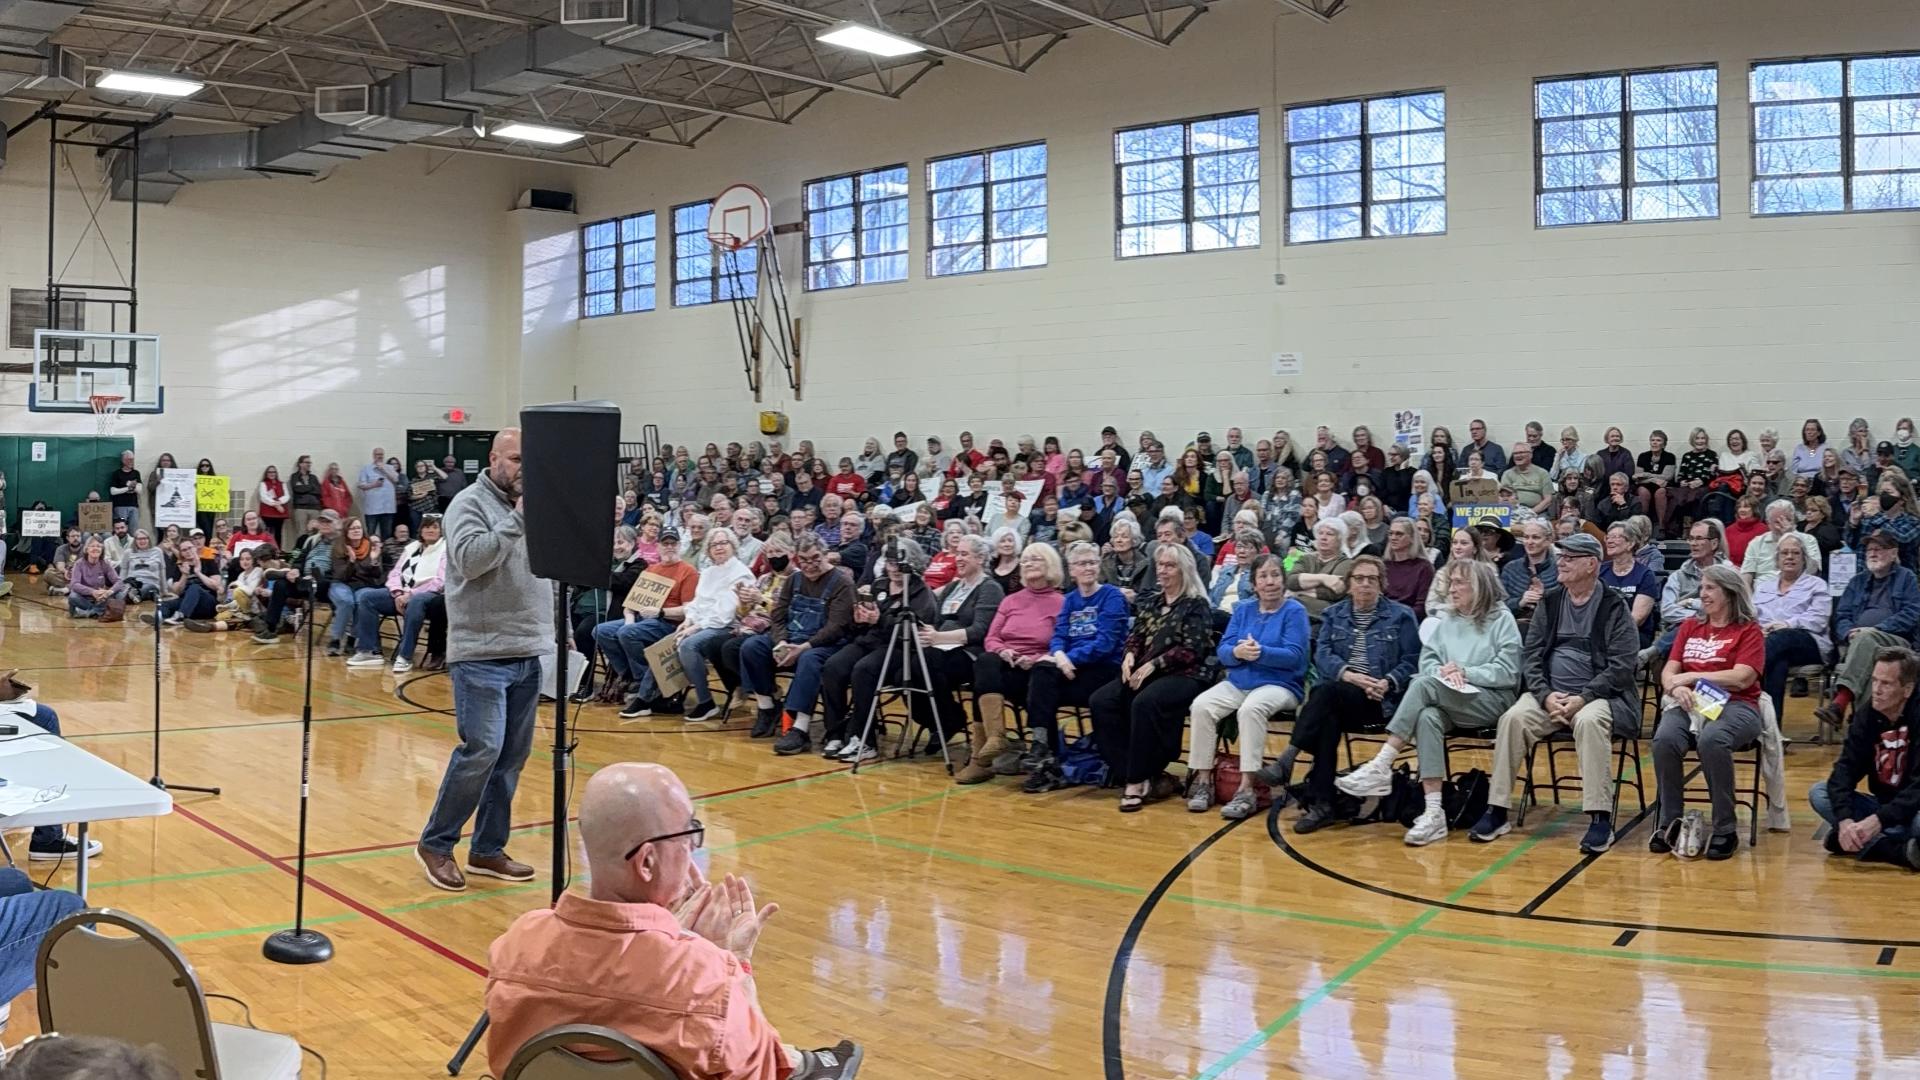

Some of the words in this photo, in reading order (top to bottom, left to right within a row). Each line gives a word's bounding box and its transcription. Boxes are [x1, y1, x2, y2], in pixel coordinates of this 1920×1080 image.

[1456, 507, 1472, 516] WE
[1474, 507, 1510, 516] STAND
[636, 578, 671, 596] DEPORT
[630, 591, 659, 607] MUSK
